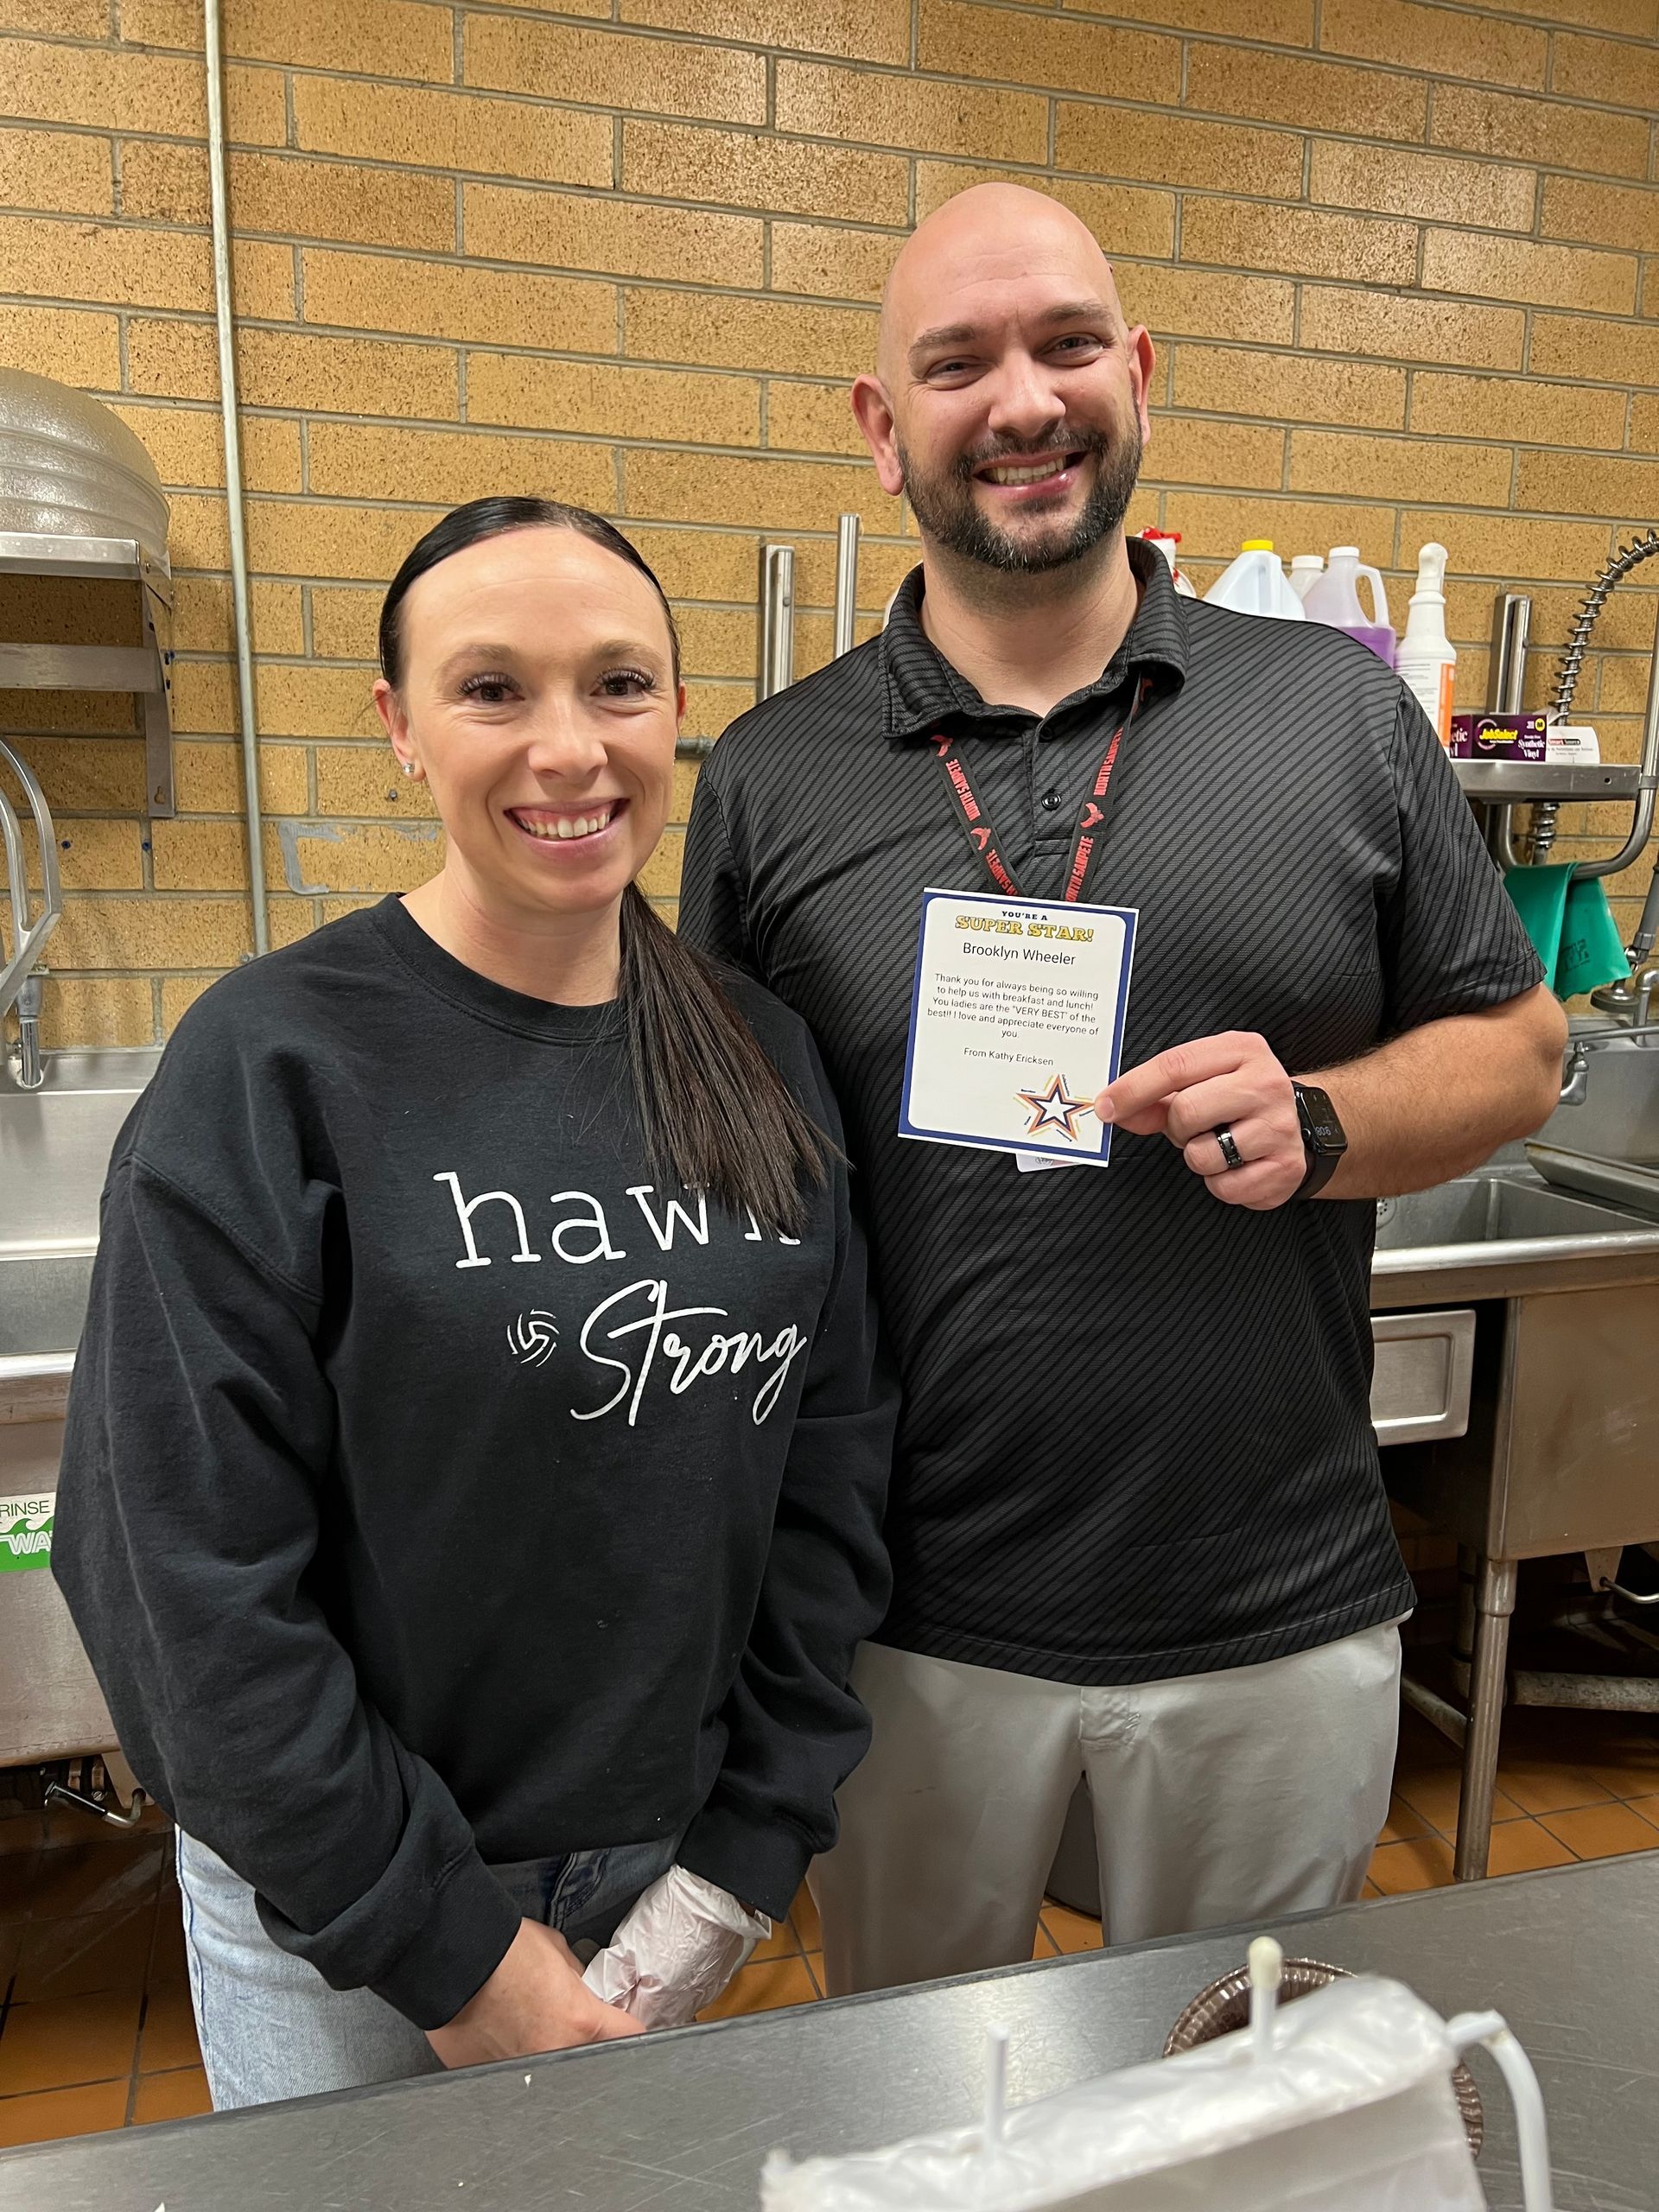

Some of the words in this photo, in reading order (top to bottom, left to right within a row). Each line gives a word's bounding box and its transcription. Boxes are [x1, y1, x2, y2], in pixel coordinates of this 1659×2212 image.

[946, 759, 970, 794] SANPETE
[959, 791, 981, 821] NORTH
[986, 849, 1012, 889] SANPETE
[1072, 836, 1094, 876] SANPETE
[1065, 874, 1080, 902] ORTH
[955, 915, 1023, 935] SUPER
[1027, 923, 1094, 942] STAR!
[1001, 911, 1038, 920] YOU'RE
[963, 942, 1019, 961] Brooklyn
[1023, 949, 1076, 965] Wheeler
[935, 973, 962, 984] Thank
[982, 978, 995, 987] for
[996, 981, 1027, 991] always
[1029, 984, 1054, 995] being
[1070, 989, 1099, 1001] willing
[948, 986, 967, 997] help
[982, 991, 1001, 1000] with
[1002, 992, 1045, 1006] breakfast
[1046, 999, 1064, 1007] and
[932, 996, 949, 1007] You
[951, 999, 977, 1009] ladies
[995, 1004, 1010, 1013] the
[1069, 1013, 1079, 1021] of
[1081, 1014, 1096, 1023] the
[958, 1011, 976, 1020] love
[997, 1017, 1045, 1029] appreciate
[1046, 1023, 1087, 1034] everyone
[1089, 1027, 1099, 1035] of
[963, 1047, 987, 1058] From
[988, 1050, 1014, 1063] Kathy
[1015, 1053, 1054, 1065] Ericksen
[569, 1279, 807, 1427] Strong
[0, 1500, 50, 1517] RINSE
